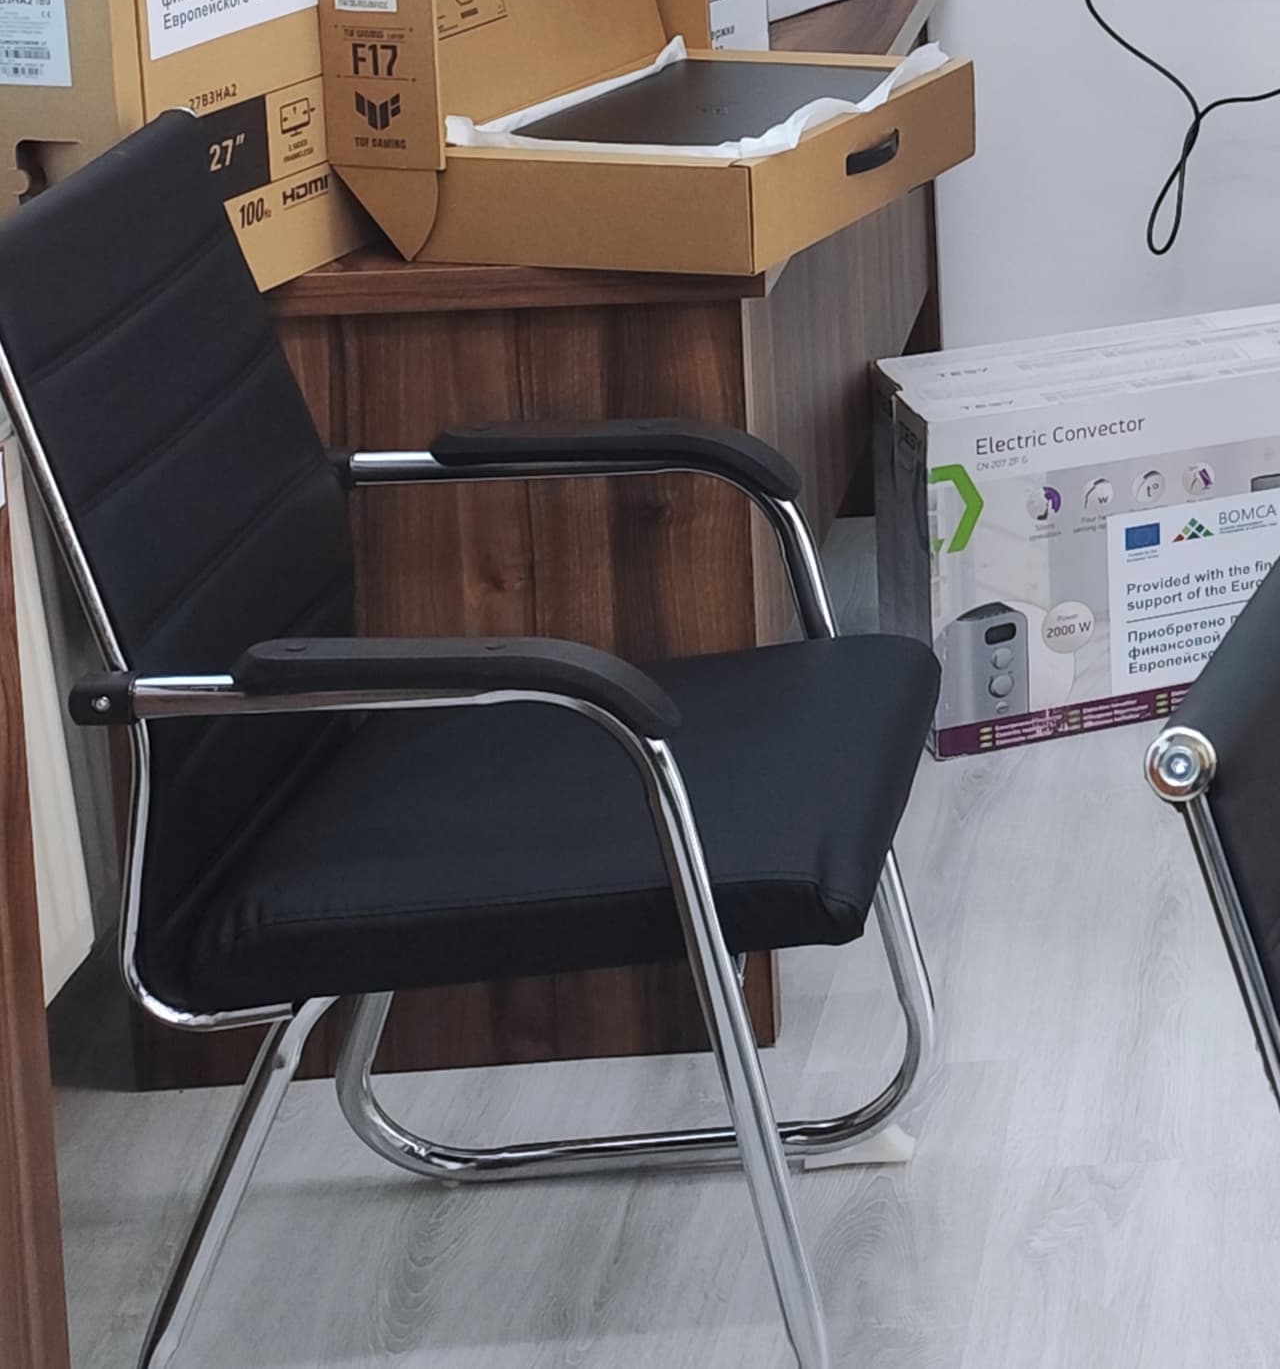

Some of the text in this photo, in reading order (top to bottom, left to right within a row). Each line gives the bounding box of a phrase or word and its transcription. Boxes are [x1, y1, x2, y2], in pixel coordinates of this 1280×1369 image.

[352, 42, 397, 77] F17
[188, 84, 237, 110] 27B3HA2
[282, 174, 328, 205] HDMI
[976, 417, 1145, 455] Electric Convector
[1219, 504, 1277, 525] BOMCA
[1127, 564, 1250, 595] Provided with the
[1127, 583, 1226, 613] support of the
[1046, 621, 1092, 638] 2000 W
[1128, 616, 1225, 644] Приобретено
[1129, 631, 1221, 661] финансовой
